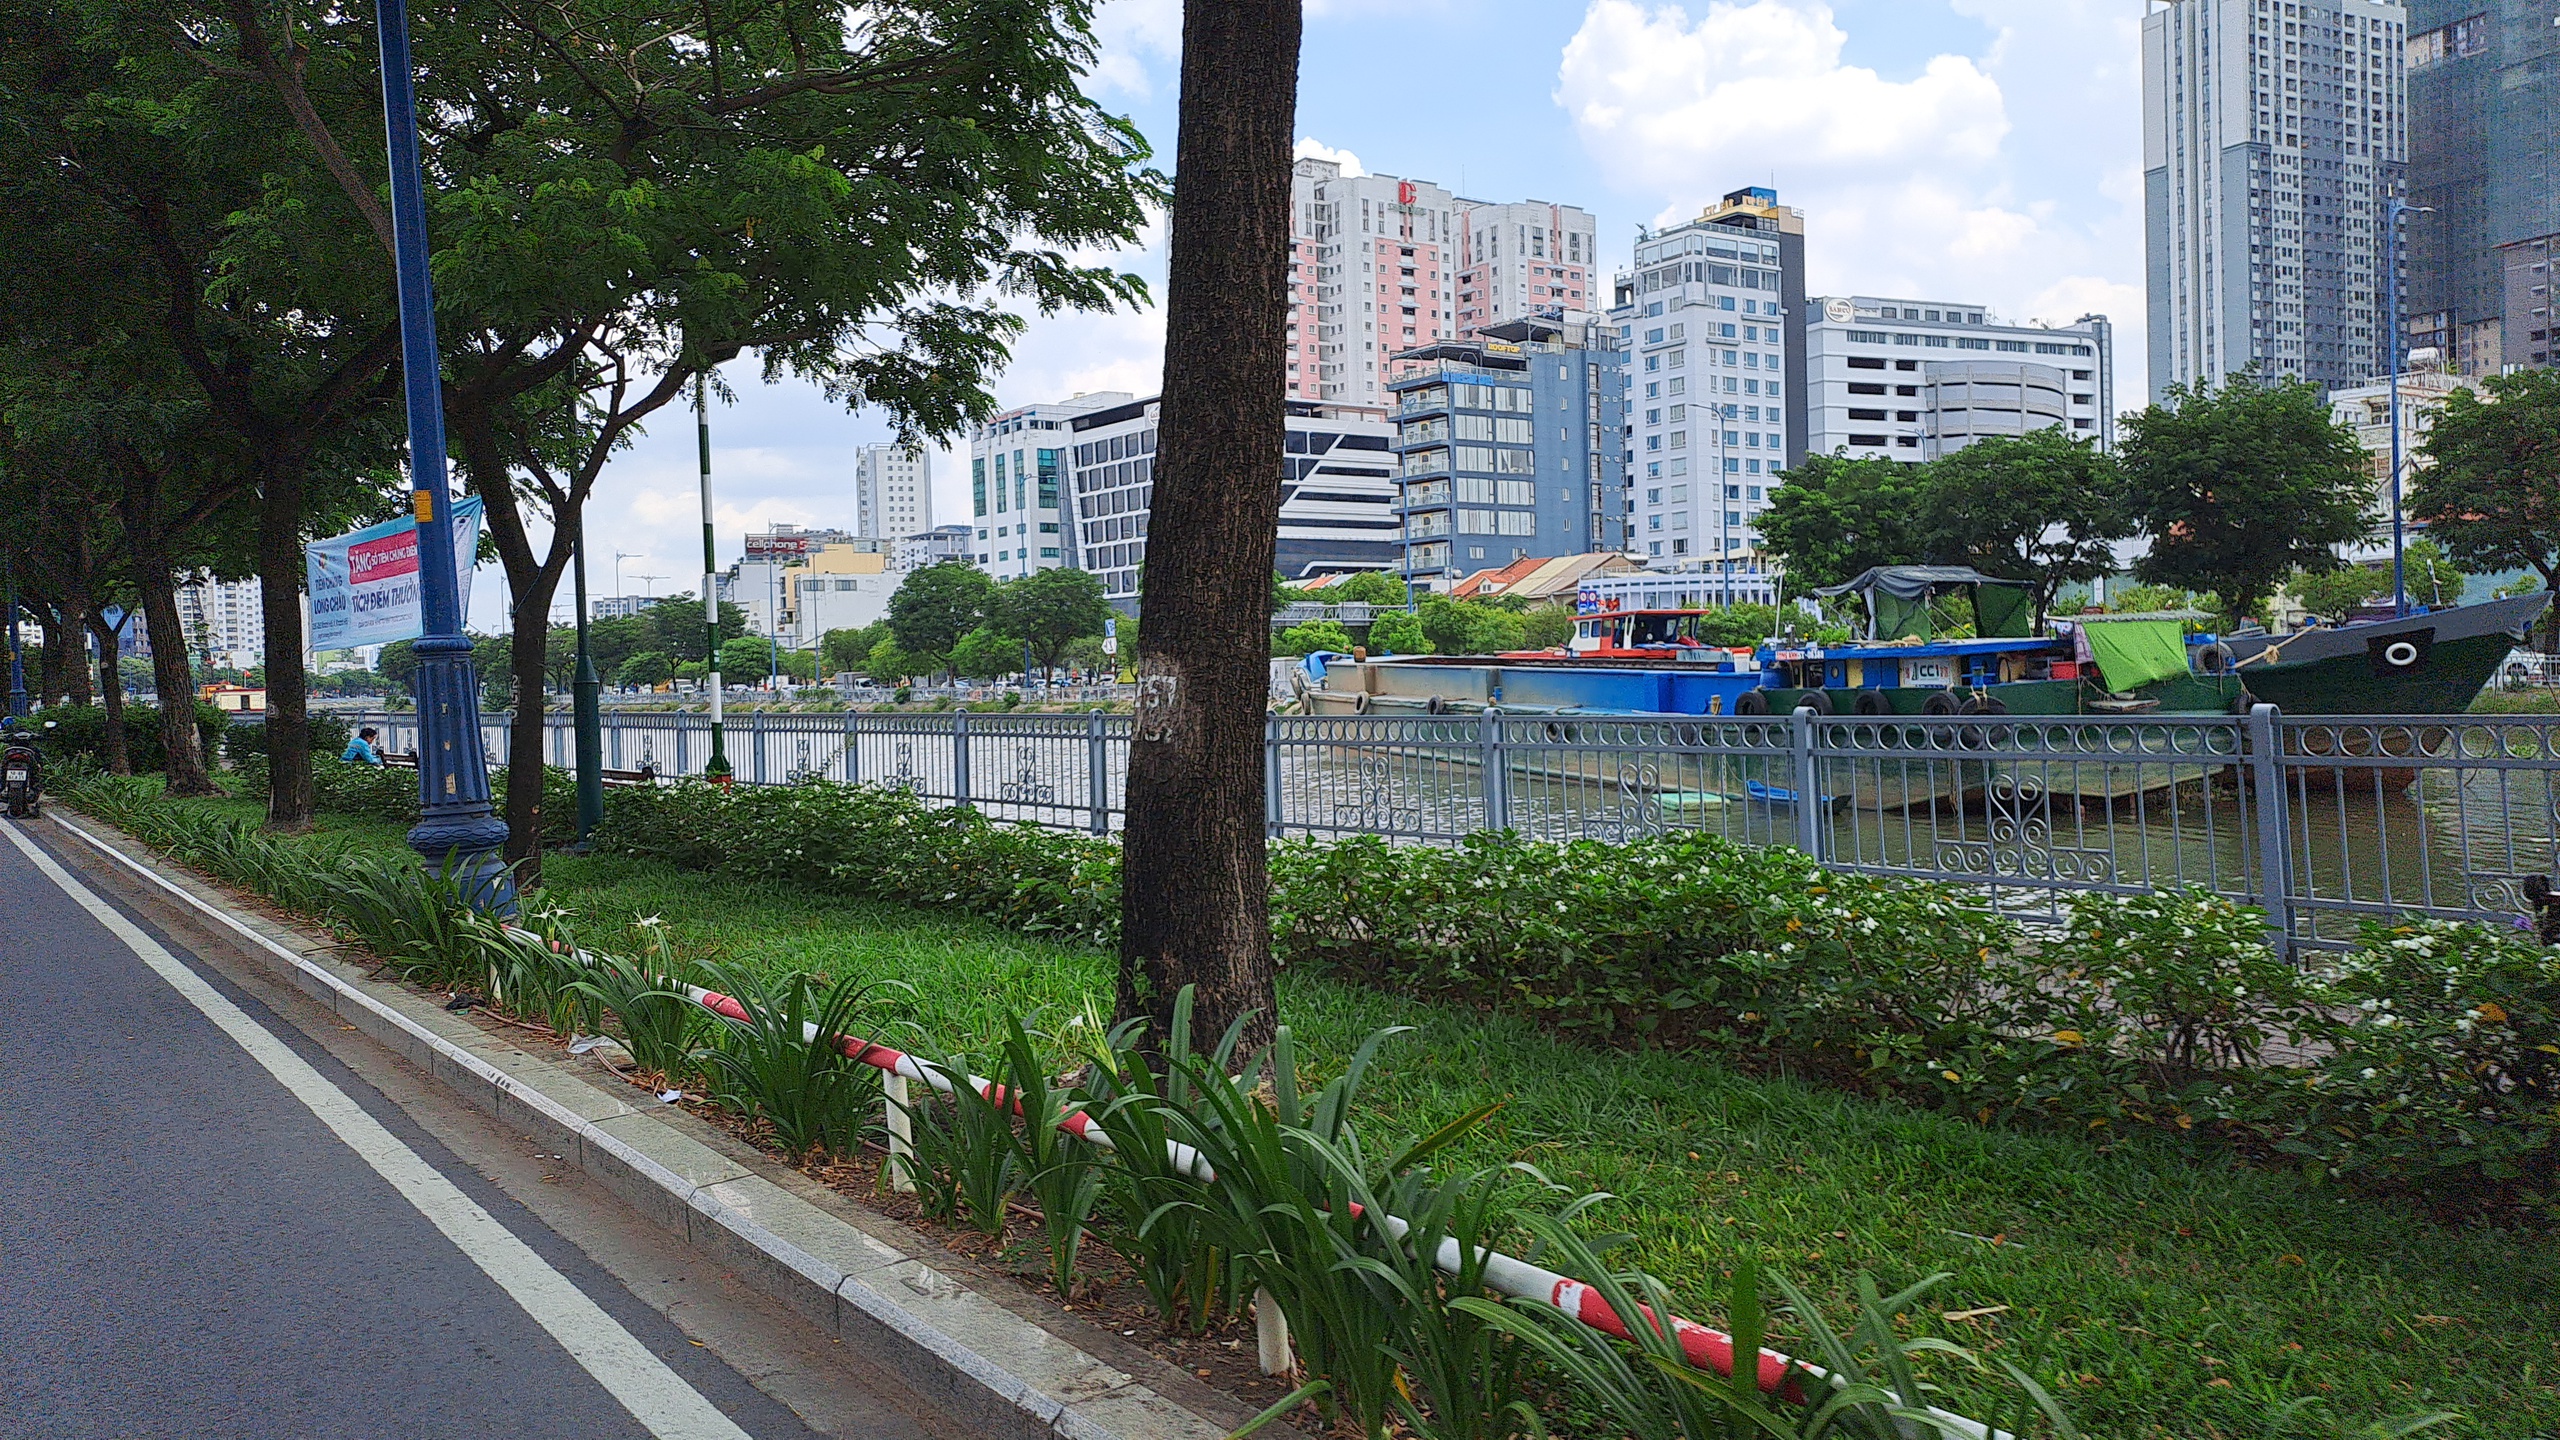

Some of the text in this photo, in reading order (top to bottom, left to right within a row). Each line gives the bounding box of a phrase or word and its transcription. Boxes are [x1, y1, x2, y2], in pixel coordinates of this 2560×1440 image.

[1488, 342, 1521, 353] ROOFTOP
[349, 550, 373, 577] TẶNG
[352, 590, 369, 613] TÍCH
[391, 577, 421, 607] THƯỞN
